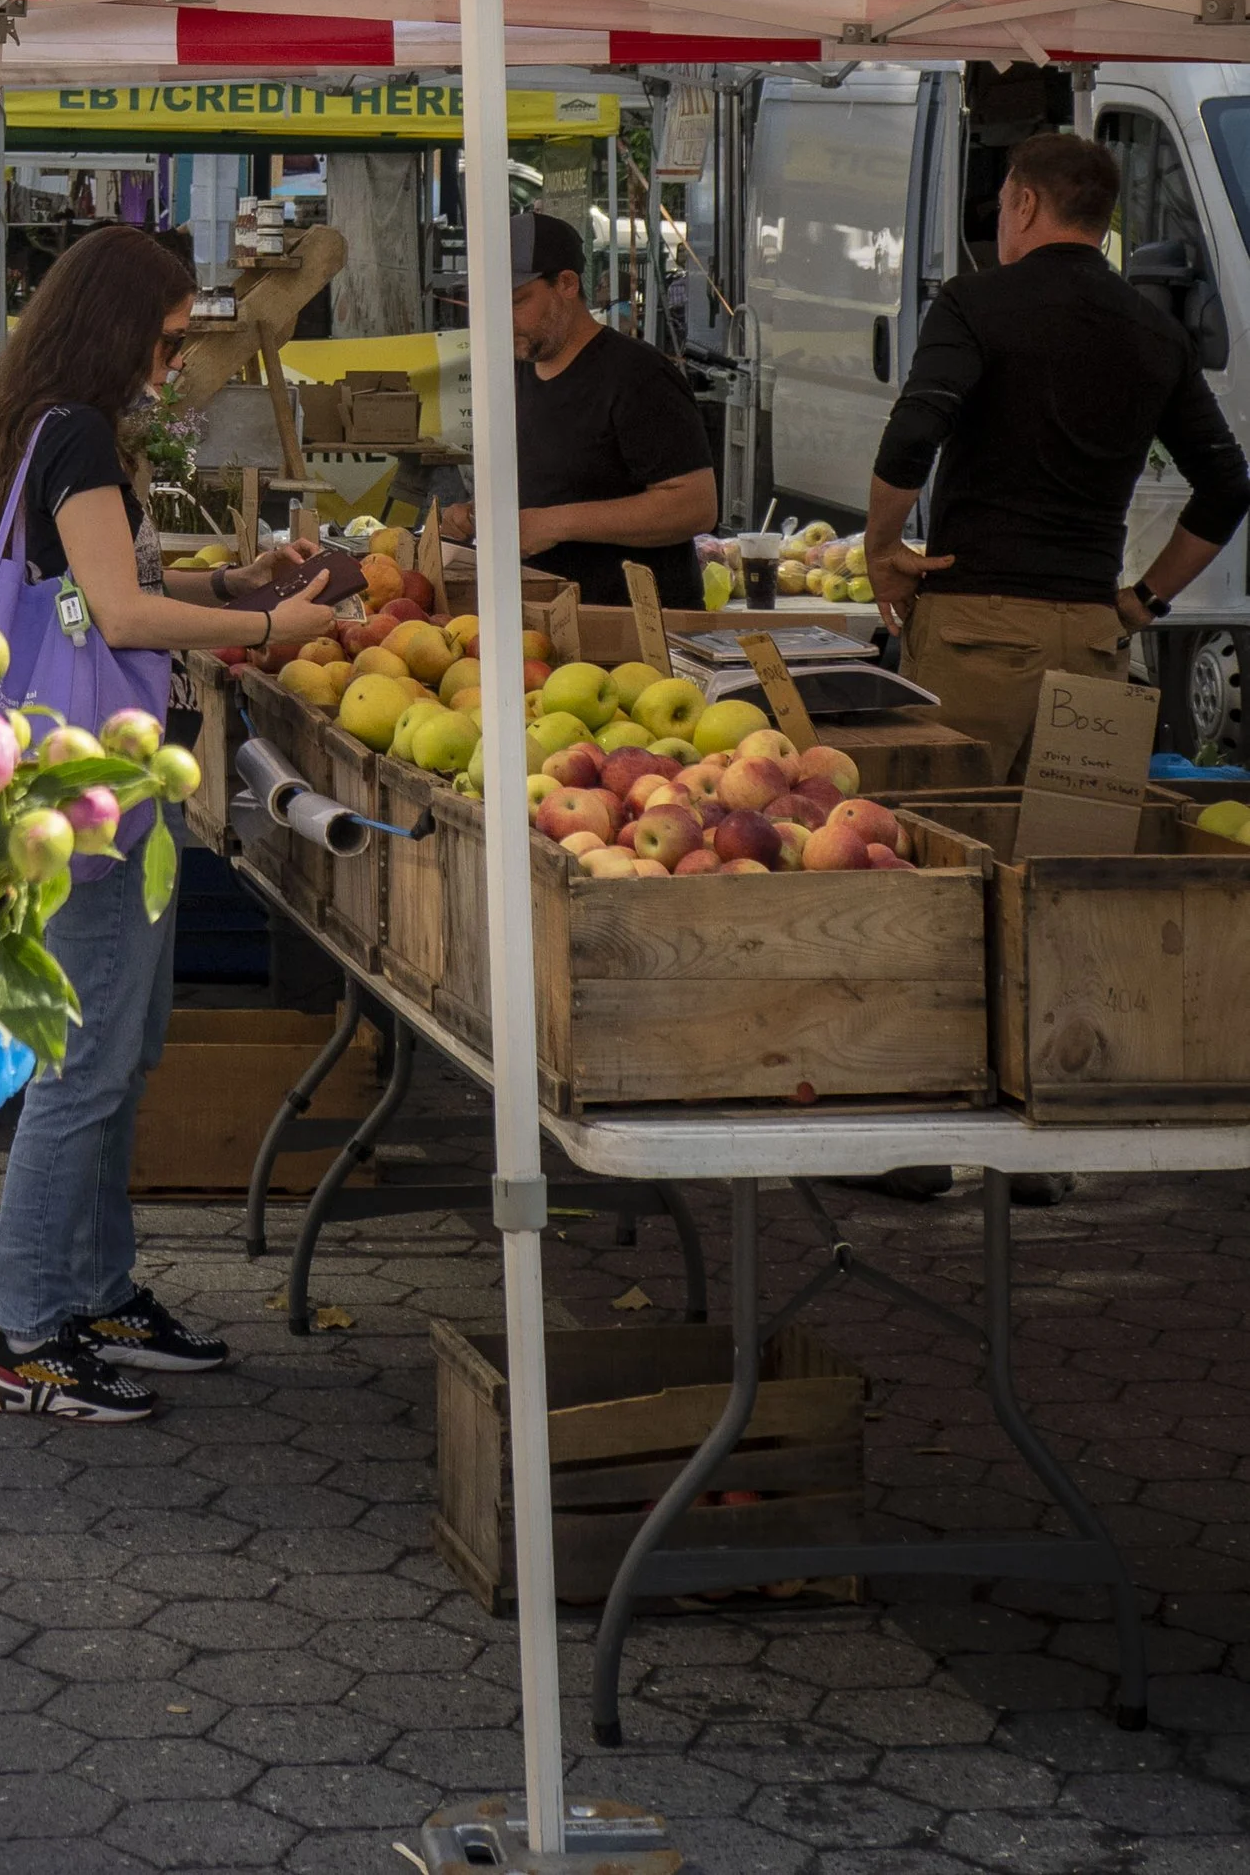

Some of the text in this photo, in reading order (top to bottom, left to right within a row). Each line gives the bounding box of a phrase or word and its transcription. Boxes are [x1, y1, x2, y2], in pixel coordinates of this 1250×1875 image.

[59, 82, 463, 116] EBT/CREDIT HERE
[1050, 688, 1119, 736] Bosc
